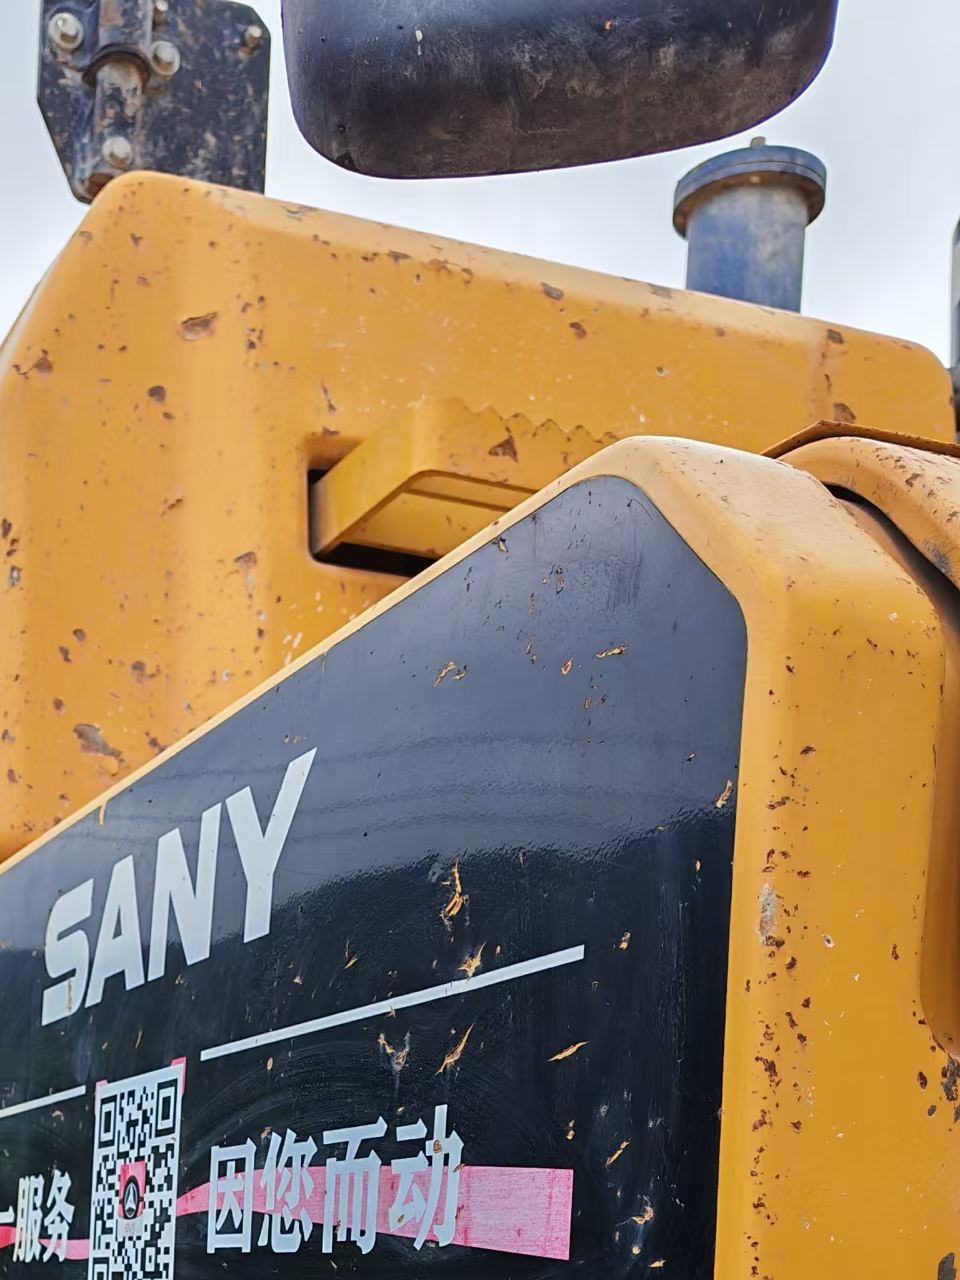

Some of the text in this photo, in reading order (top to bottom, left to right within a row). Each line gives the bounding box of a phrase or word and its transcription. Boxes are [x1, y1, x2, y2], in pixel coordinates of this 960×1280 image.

[41, 748, 317, 1027] SANY
[206, 1104, 464, 1254] 因您而动
